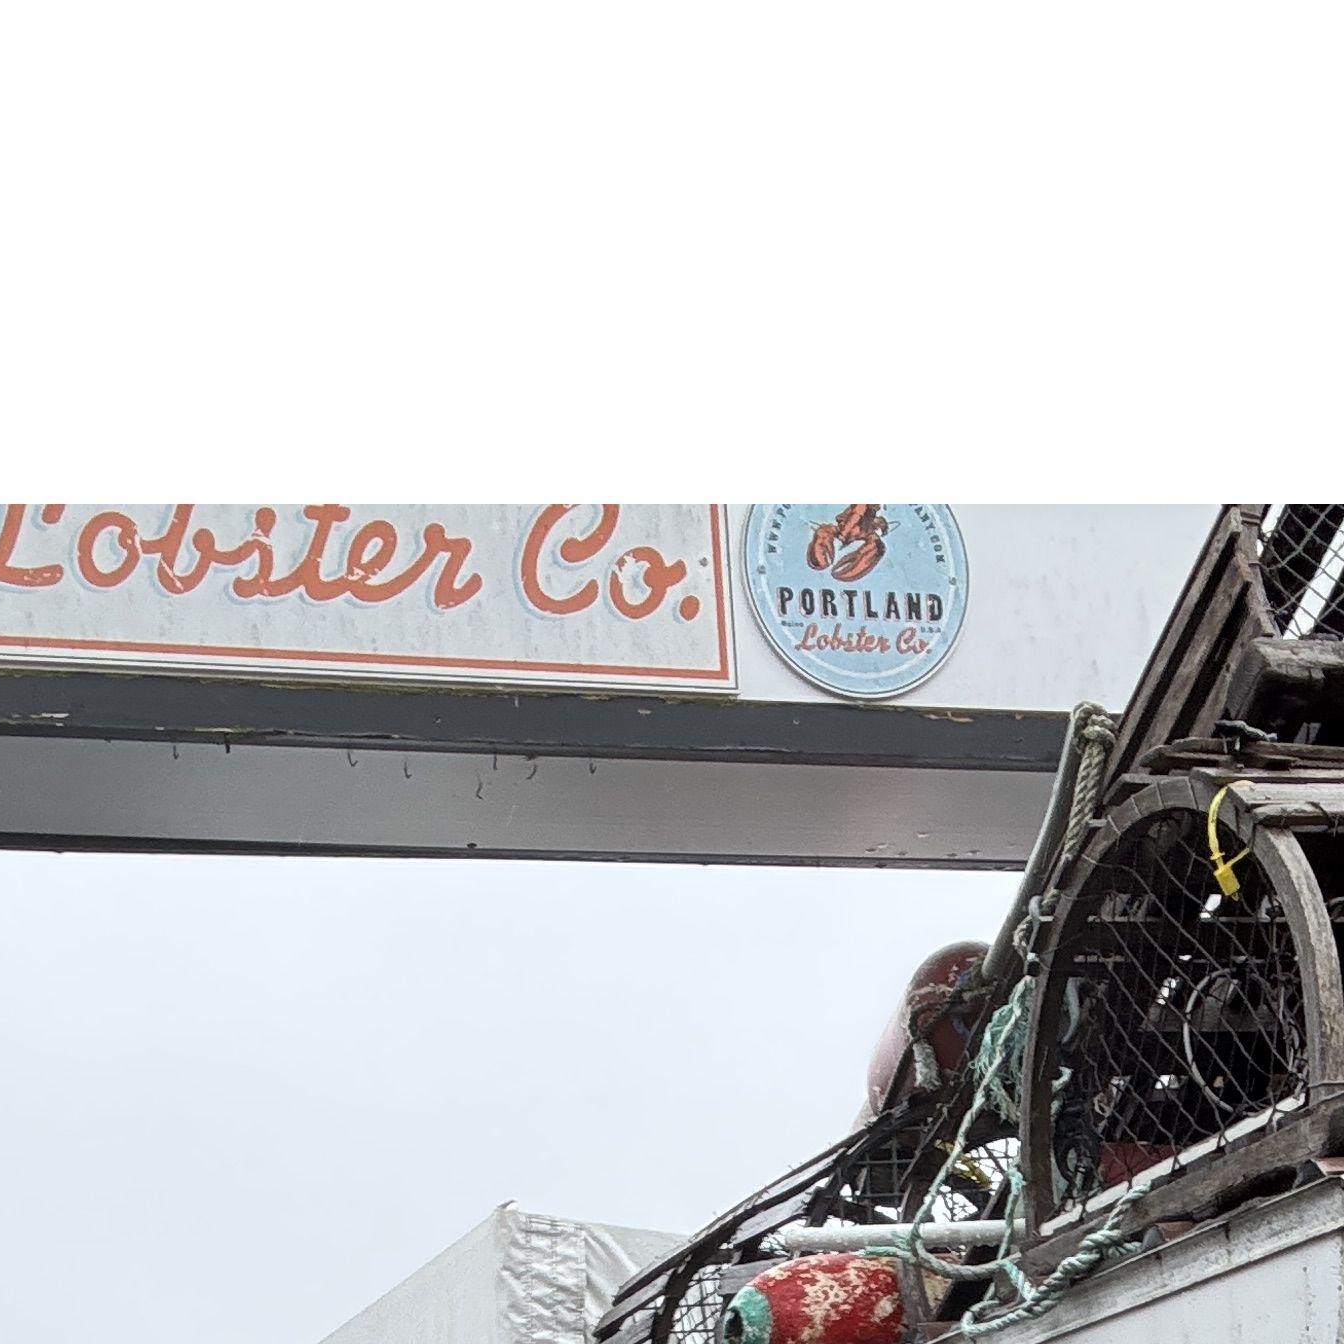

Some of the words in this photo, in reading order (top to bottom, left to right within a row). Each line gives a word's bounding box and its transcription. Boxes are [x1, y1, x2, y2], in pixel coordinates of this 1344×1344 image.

[520, 504, 701, 622] Co.
[777, 586, 944, 621] PORTLAND
[794, 622, 891, 655] Lobster
[896, 626, 933, 656] Co.
